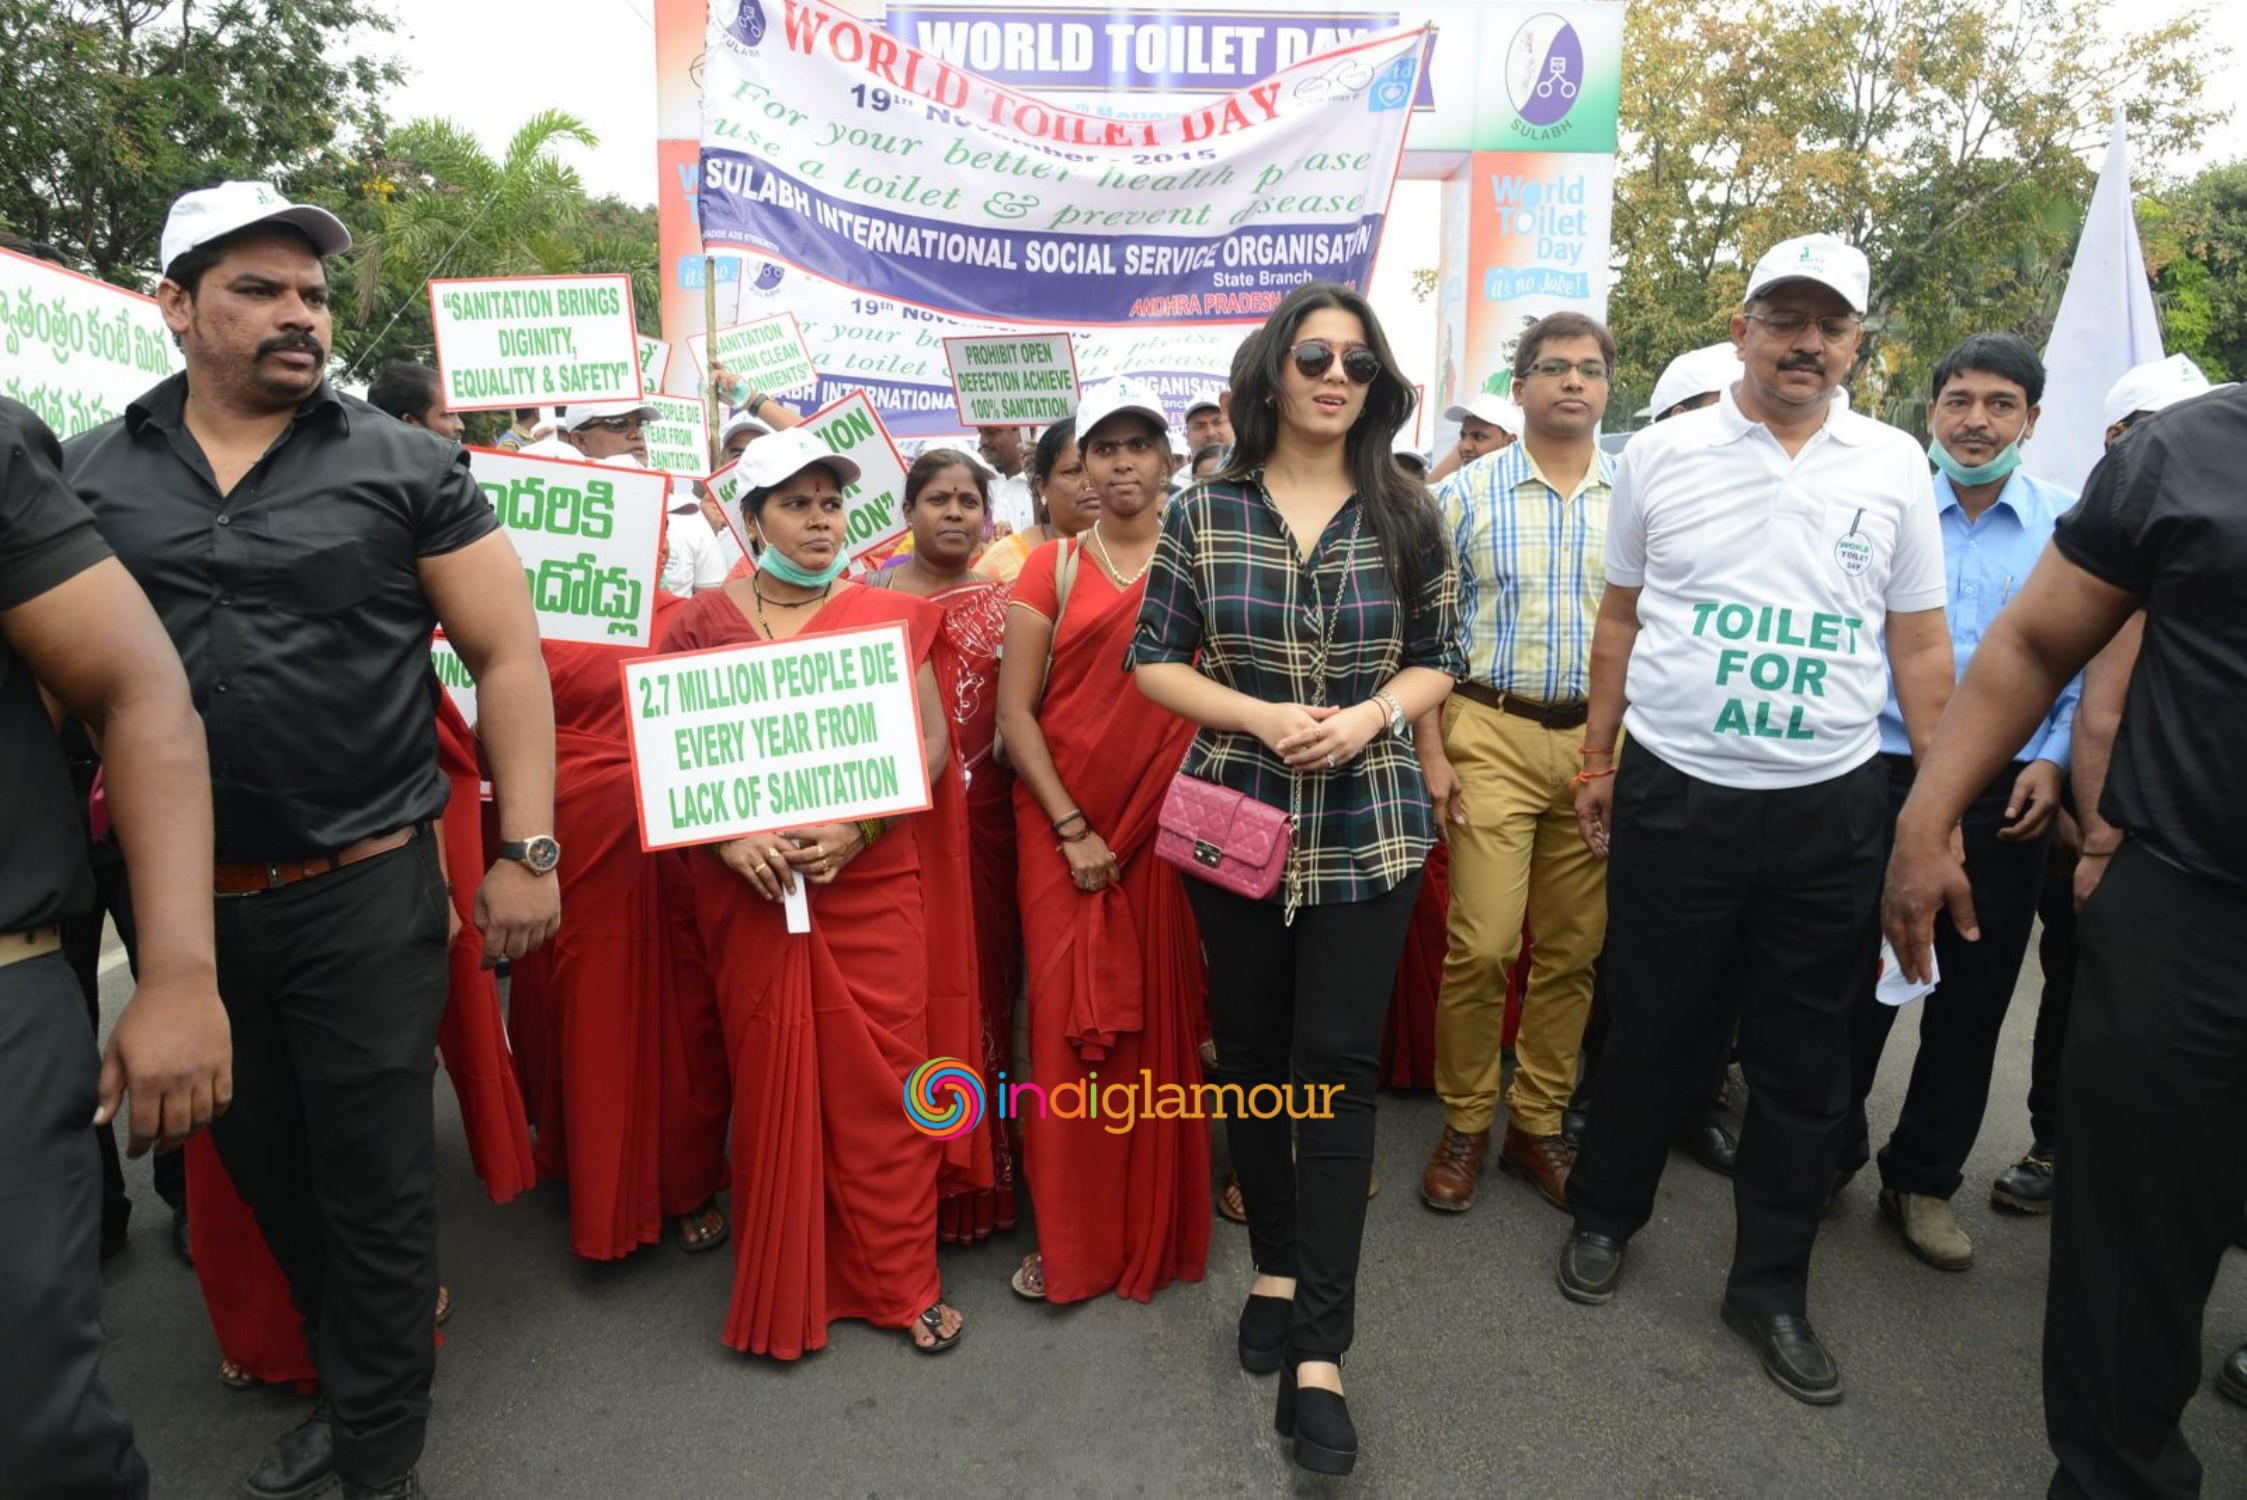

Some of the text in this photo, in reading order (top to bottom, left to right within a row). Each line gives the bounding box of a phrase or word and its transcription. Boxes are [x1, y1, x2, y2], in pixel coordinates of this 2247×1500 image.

[916, 21, 1093, 73] WORLD
[1105, 24, 1266, 76] TOILET
[783, 0, 969, 110] WORLD
[1182, 81, 1281, 144] DAY
[731, 79, 808, 126] For
[814, 121, 923, 156] your
[1252, 152, 1371, 194] pase
[1511, 118, 1572, 141] SULABH
[1132, 148, 1217, 165] 2015
[714, 117, 780, 156] use
[799, 159, 826, 179] a
[843, 168, 961, 209] toilet
[983, 192, 1040, 219] &
[1044, 203, 1212, 230] prevent
[1490, 174, 1585, 207] World
[706, 159, 811, 217] SULABH
[816, 199, 1018, 270] INTERNATIONAL
[1025, 240, 1116, 275] SOCIAL
[1124, 242, 1220, 276] SERVICE
[1222, 223, 1372, 267] ORGANISATIN
[1496, 205, 1588, 237] Toilet
[1536, 236, 1585, 265] Day
[1213, 269, 1313, 288] State Branch
[1516, 271, 1536, 293] no
[443, 287, 620, 321] “SANITATION BRINGS
[851, 298, 894, 315] 19th
[1129, 295, 1203, 317] ANDHRA
[1204, 291, 1282, 315] PRADESH
[498, 326, 578, 360] DIGINITY,
[822, 322, 902, 343] your
[759, 341, 801, 367] CLEAN
[845, 351, 928, 376] toilet
[964, 344, 1018, 367] PROHIBIT
[1021, 343, 1053, 364] OPEN
[451, 367, 535, 398] EQUALITY
[542, 365, 555, 393] &
[559, 361, 629, 393] SAFETY”
[957, 369, 1072, 393] DEFECTION ACHIEVE
[686, 405, 701, 425] DIE
[971, 397, 1069, 419] 100% SANITATION
[670, 427, 692, 447] FROM
[650, 450, 701, 471] SANITATION
[1840, 541, 1870, 553] WORLD
[1841, 550, 1868, 561] TOILET
[1691, 601, 1863, 654] TOILET
[639, 641, 898, 718] 2.7 MILLION PEOPLE DIE
[1715, 649, 1828, 697] FOR
[1713, 698, 1814, 740] ALL
[674, 701, 878, 770] EVERY YEAR FROM
[668, 755, 899, 829] LACK OF SANITATION
